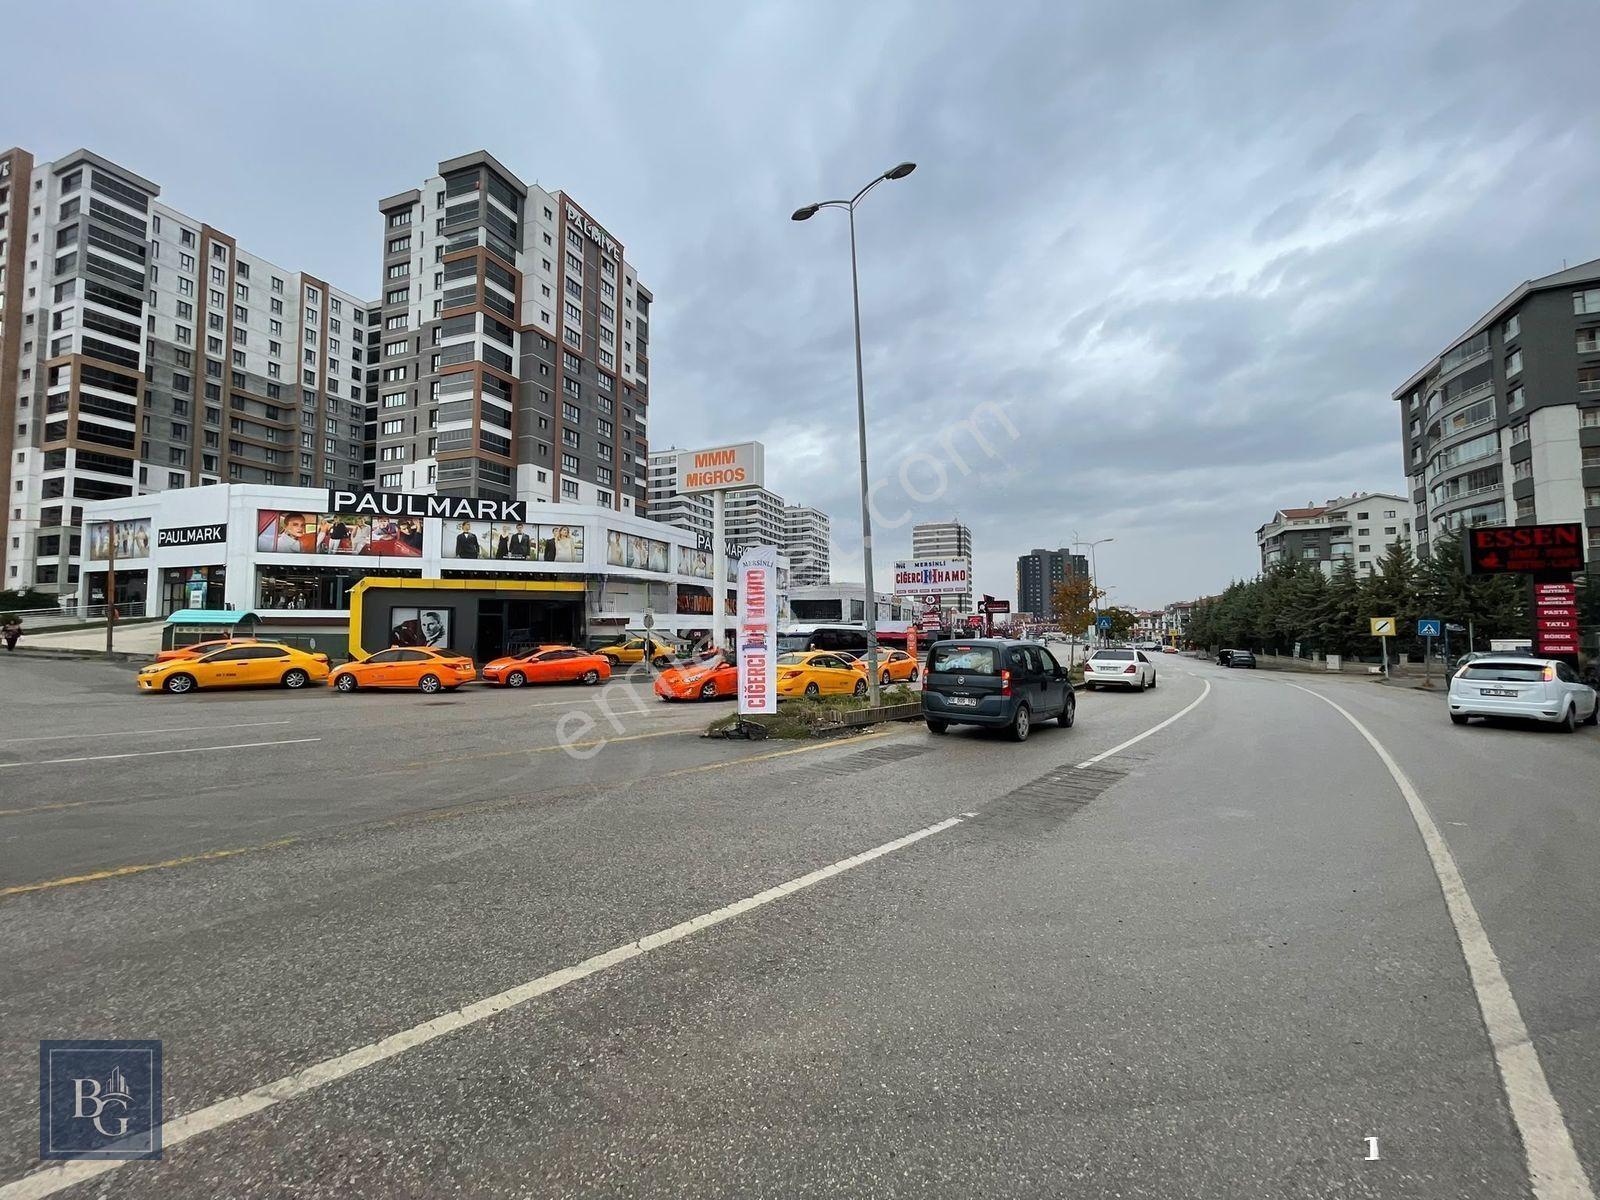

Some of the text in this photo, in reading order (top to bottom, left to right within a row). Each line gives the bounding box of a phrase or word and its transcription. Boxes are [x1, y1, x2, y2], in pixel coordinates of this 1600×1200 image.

[694, 450, 736, 468] MMM
[334, 491, 522, 521] PAULMARK
[158, 526, 222, 544] PAULMARK
[697, 534, 750, 558] PAMARK
[1476, 526, 1578, 548] ESSEN
[937, 570, 966, 583] HAMO
[744, 654, 767, 709] CİĞERCİ
